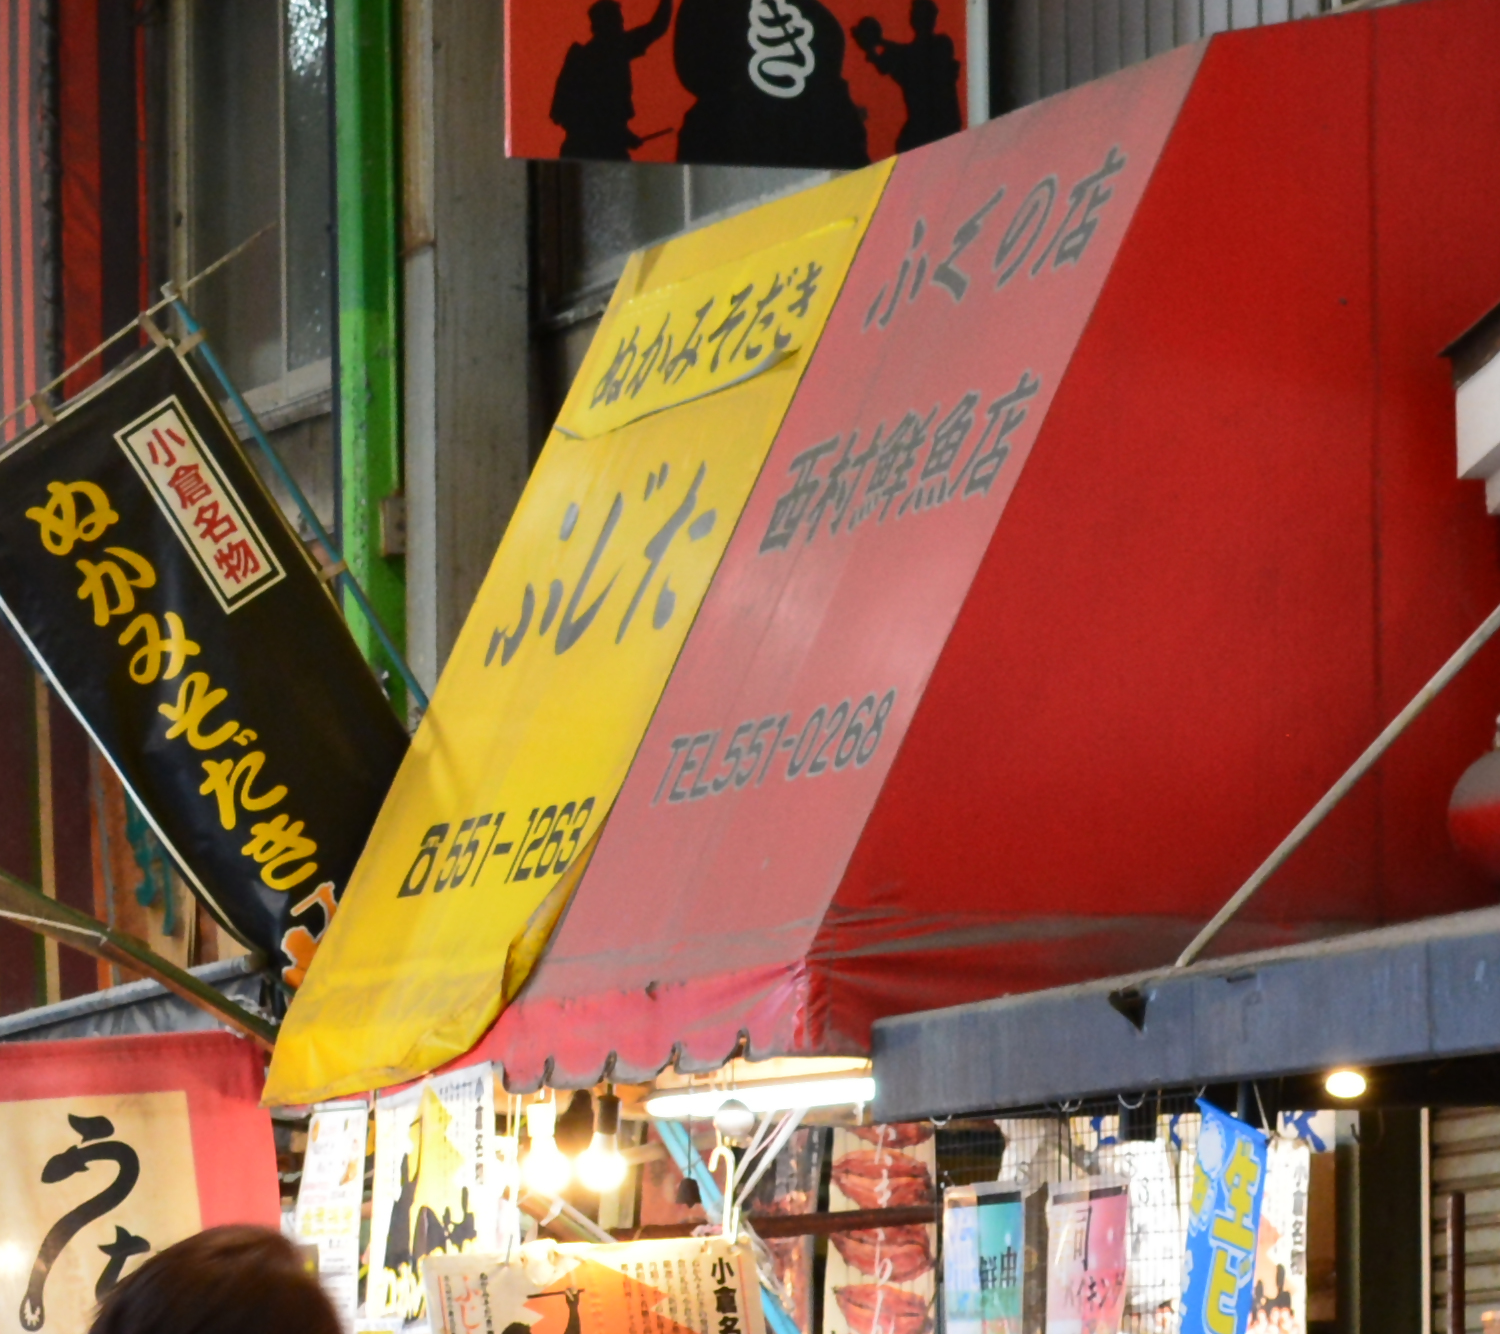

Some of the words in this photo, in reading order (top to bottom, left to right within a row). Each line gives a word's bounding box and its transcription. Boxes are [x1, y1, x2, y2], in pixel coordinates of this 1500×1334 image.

[863, 144, 1127, 331] ふくの店
[590, 260, 824, 411] ぬかみそだき
[147, 425, 262, 587] 小倉名物
[759, 370, 1040, 556] 西村鮮魚店
[485, 461, 718, 668] ふじた
[25, 479, 320, 892] ぬかみそだき
